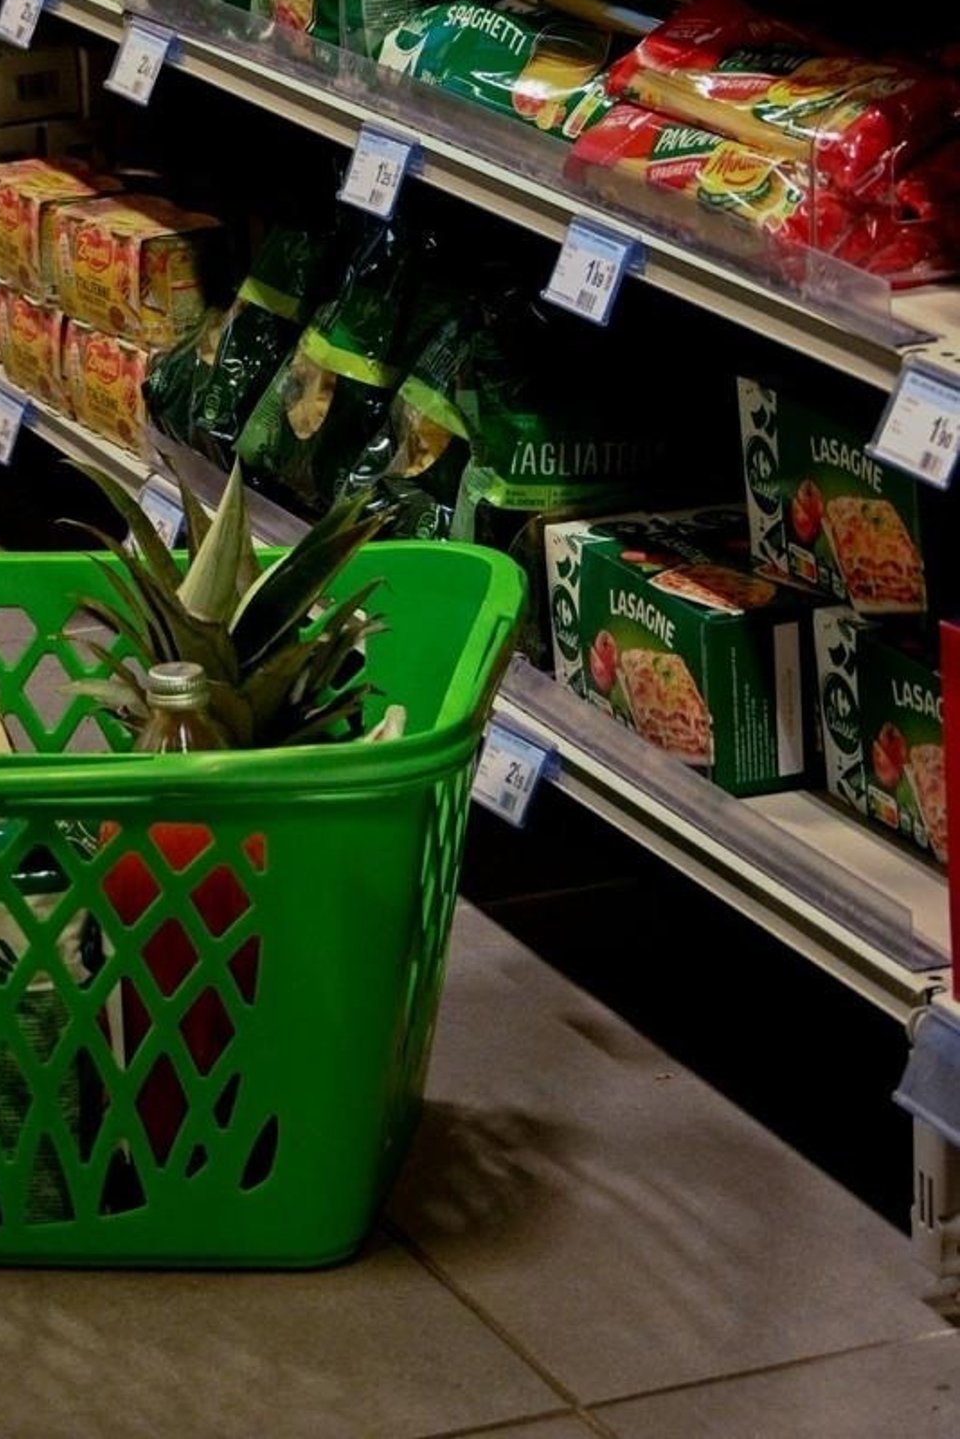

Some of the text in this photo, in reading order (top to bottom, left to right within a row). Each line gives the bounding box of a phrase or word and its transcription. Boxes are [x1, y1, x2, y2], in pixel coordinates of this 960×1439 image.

[443, 4, 528, 57] SPAGHETTI
[809, 434, 884, 494] LASAGNE
[608, 588, 677, 650] LASAGNE
